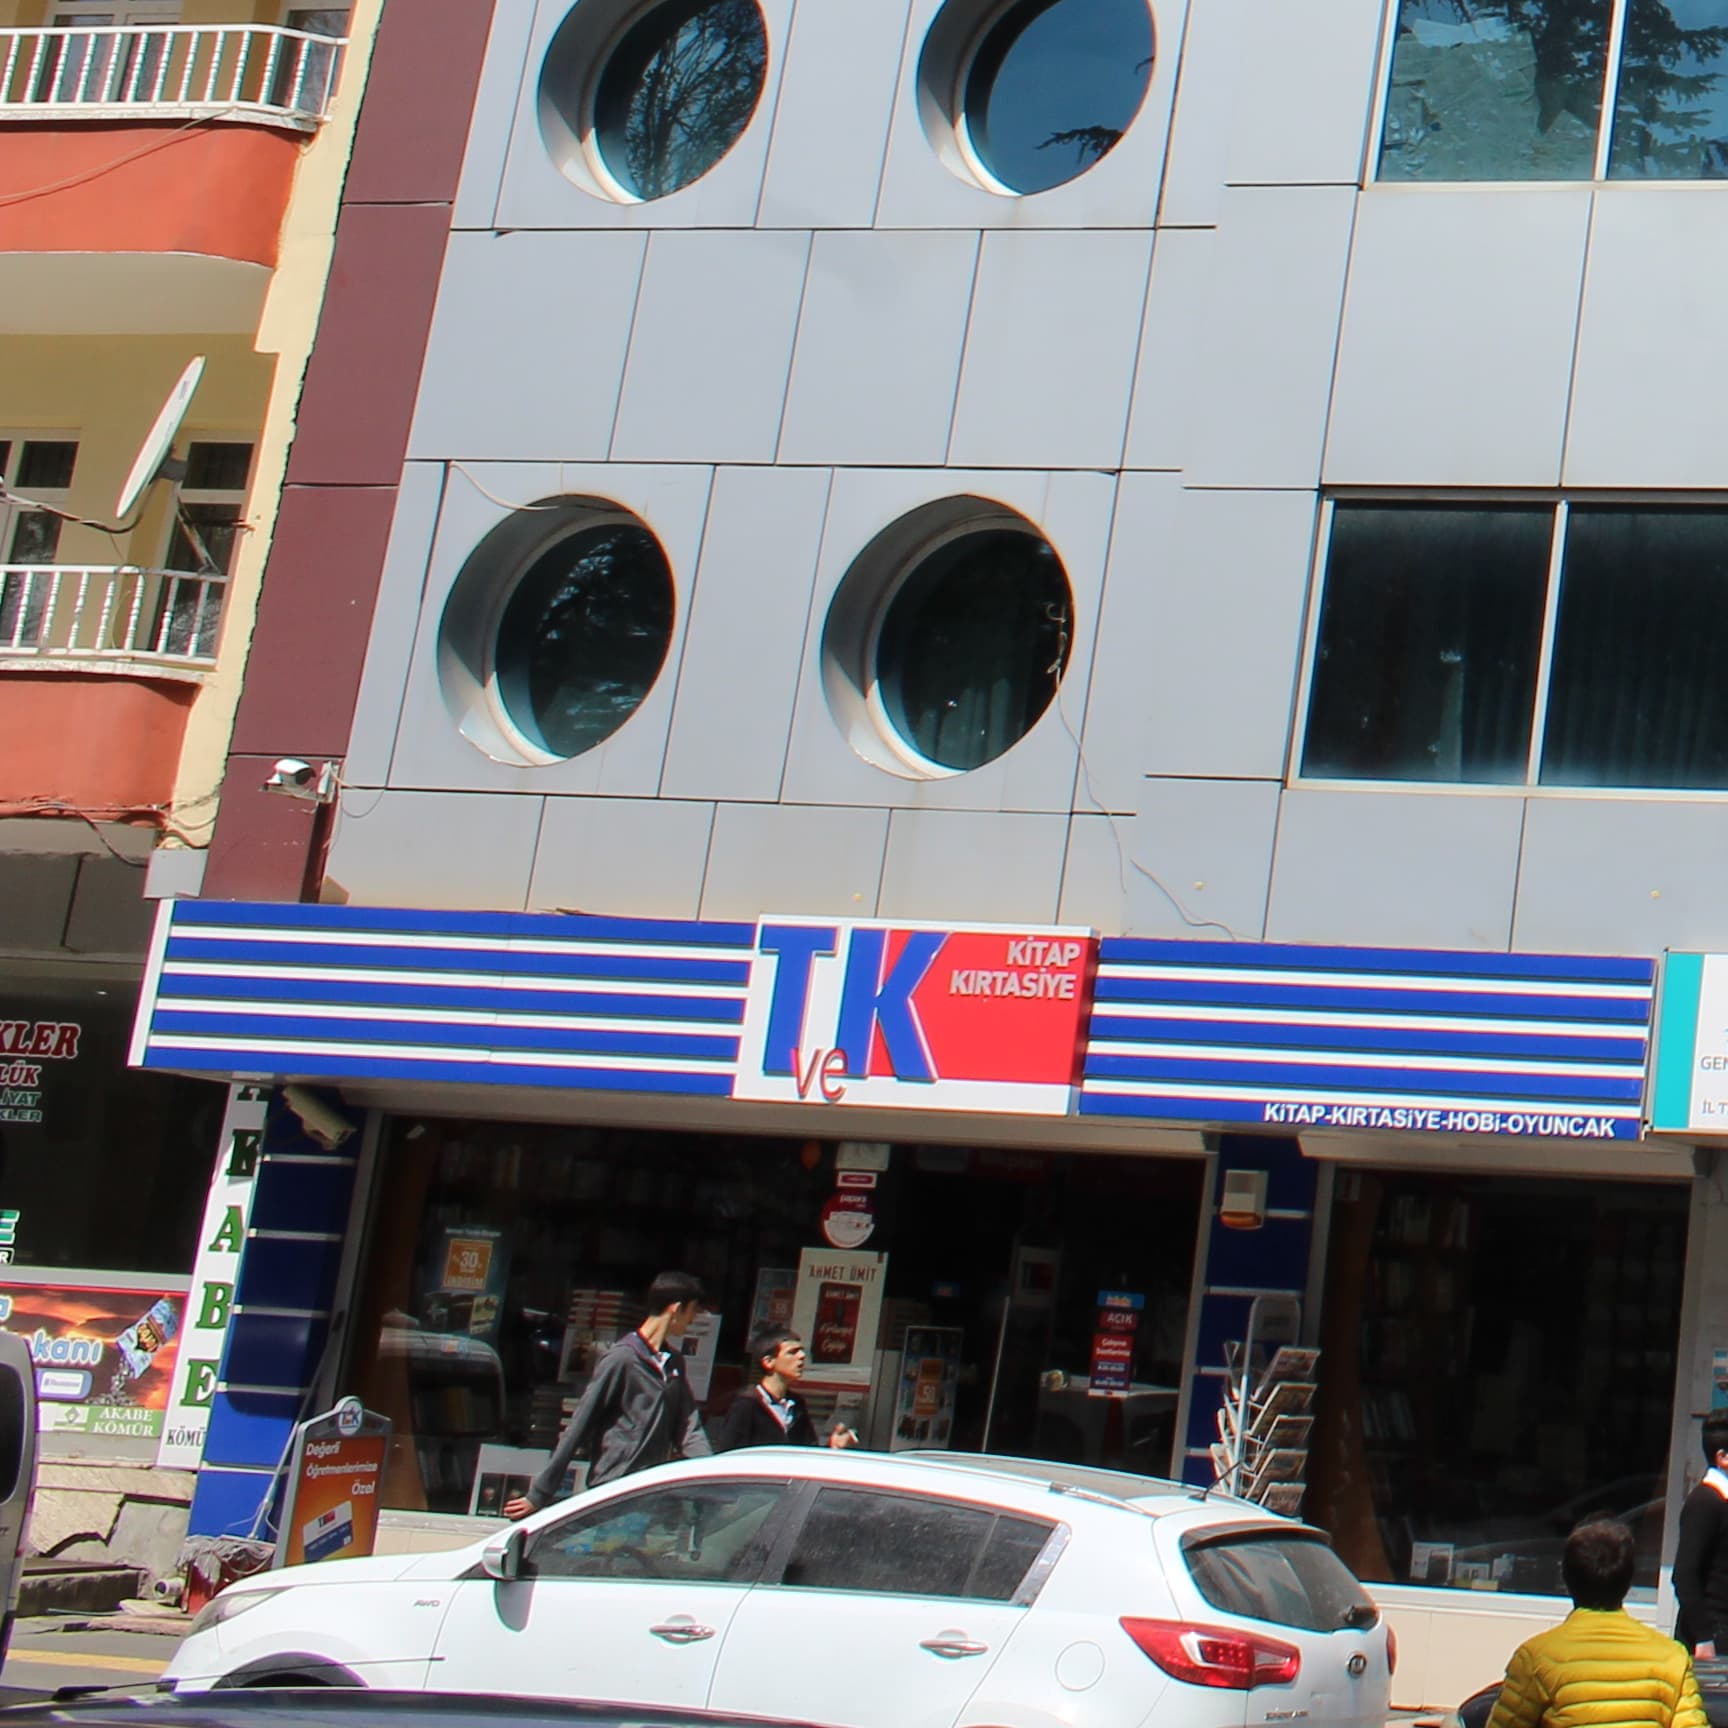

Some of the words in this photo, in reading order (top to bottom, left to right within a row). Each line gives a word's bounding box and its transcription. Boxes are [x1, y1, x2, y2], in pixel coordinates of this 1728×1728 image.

[1006, 936, 1081, 968] KİTAP
[949, 967, 1077, 1001] KIRTASİYE
[791, 1047, 849, 1101] ve
[1701, 1101, 1715, 1115] İL
[99, 1404, 153, 1421] AKABE
[93, 1421, 154, 1437] KÖMÜR
[306, 1441, 341, 1458] Değerli
[352, 1478, 376, 1495] Özel
